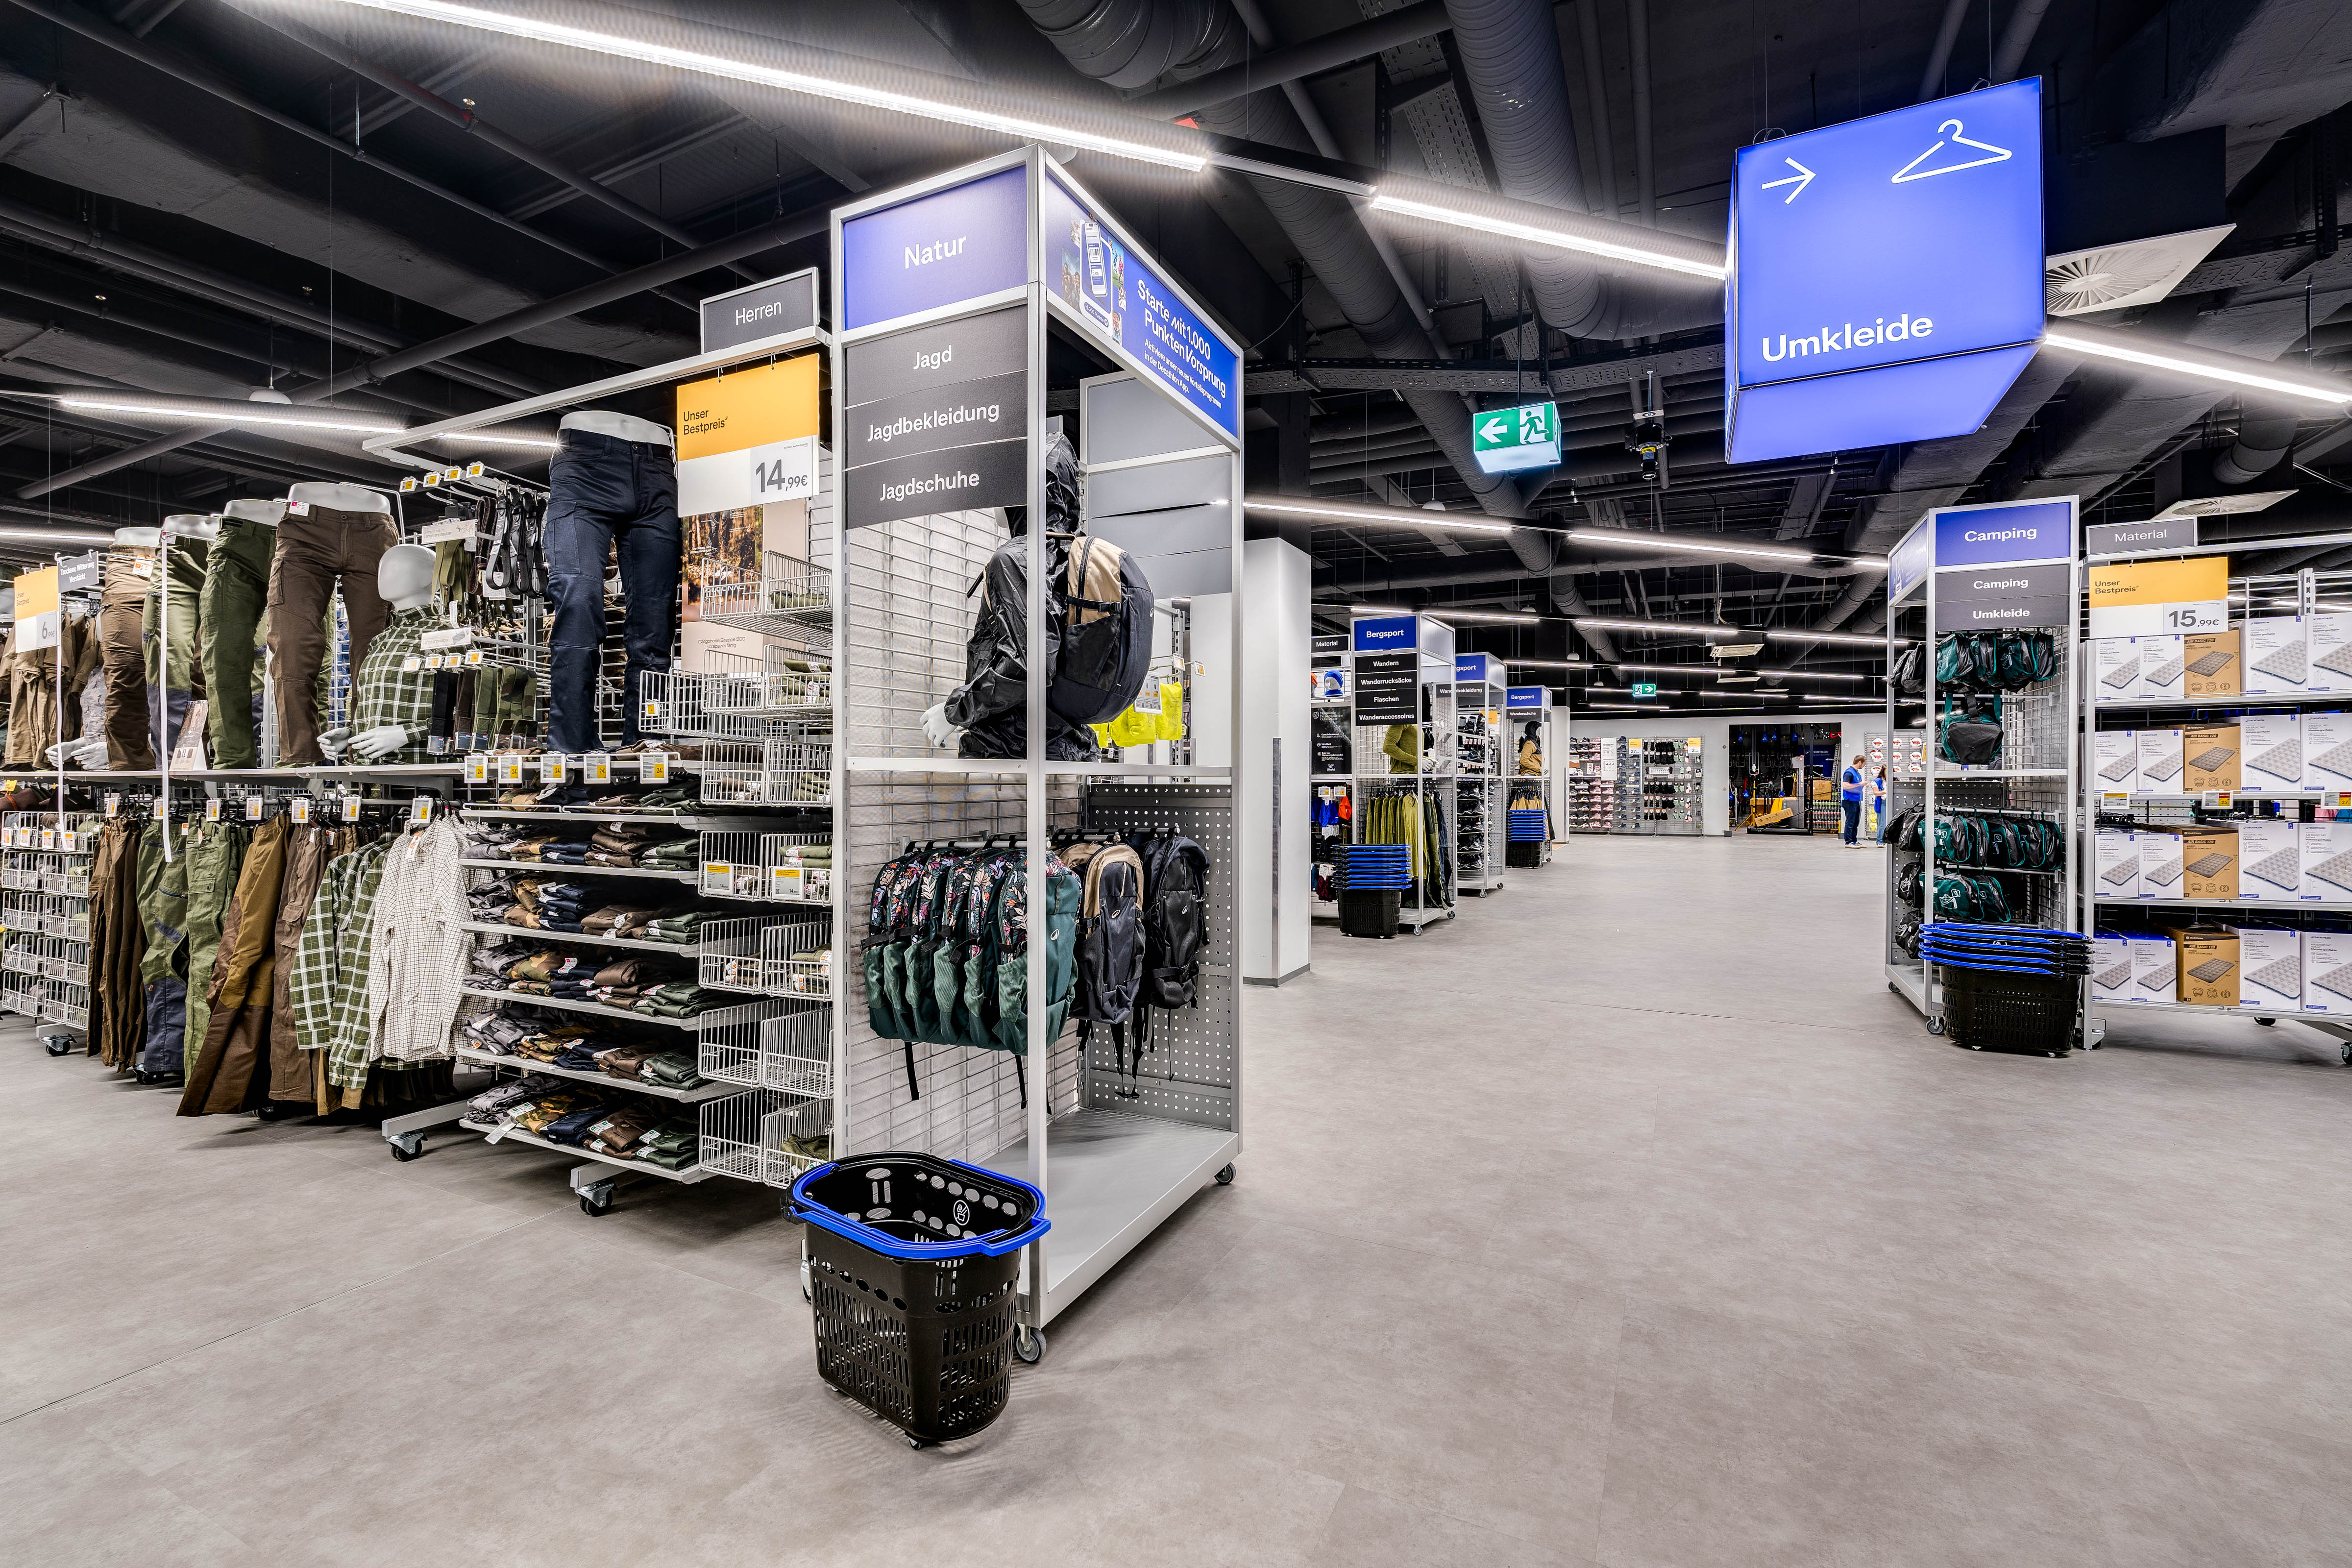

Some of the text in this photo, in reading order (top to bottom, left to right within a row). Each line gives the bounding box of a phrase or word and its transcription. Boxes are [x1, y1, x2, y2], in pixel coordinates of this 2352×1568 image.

[904, 236, 967, 270] Natur
[735, 300, 782, 326] Herren
[1138, 279, 1170, 322] Starte
[1187, 325, 1211, 360] 1.000
[1762, 313, 1934, 363] Umkleide
[913, 345, 952, 370] Jagd
[1145, 308, 1226, 398] Punkten Vorsprung
[1145, 350, 1150, 361] in
[1157, 361, 1179, 385] Decathlon
[1179, 379, 1189, 394] App.
[1145, 339, 1222, 409] Aktiviere unser neues Vorteilsprogramm
[684, 408, 710, 421] Unser
[867, 403, 1000, 442] Jagdbekleidung
[684, 418, 725, 436] Bestpreis
[756, 459, 808, 493] 14,99€
[880, 470, 980, 502] Jagdschuhe
[1964, 527, 2037, 542] Camping
[2114, 529, 2167, 542] Material
[60, 562, 95, 576] Trockene Witterung
[69, 573, 86, 583] Verstärkt
[1973, 579, 2029, 589] Camping
[2095, 586, 2136, 594] Bestpreis
[1973, 608, 2030, 619] Umkleide
[2169, 610, 2219, 627] 15,99€
[1366, 629, 1404, 638] Bergsport
